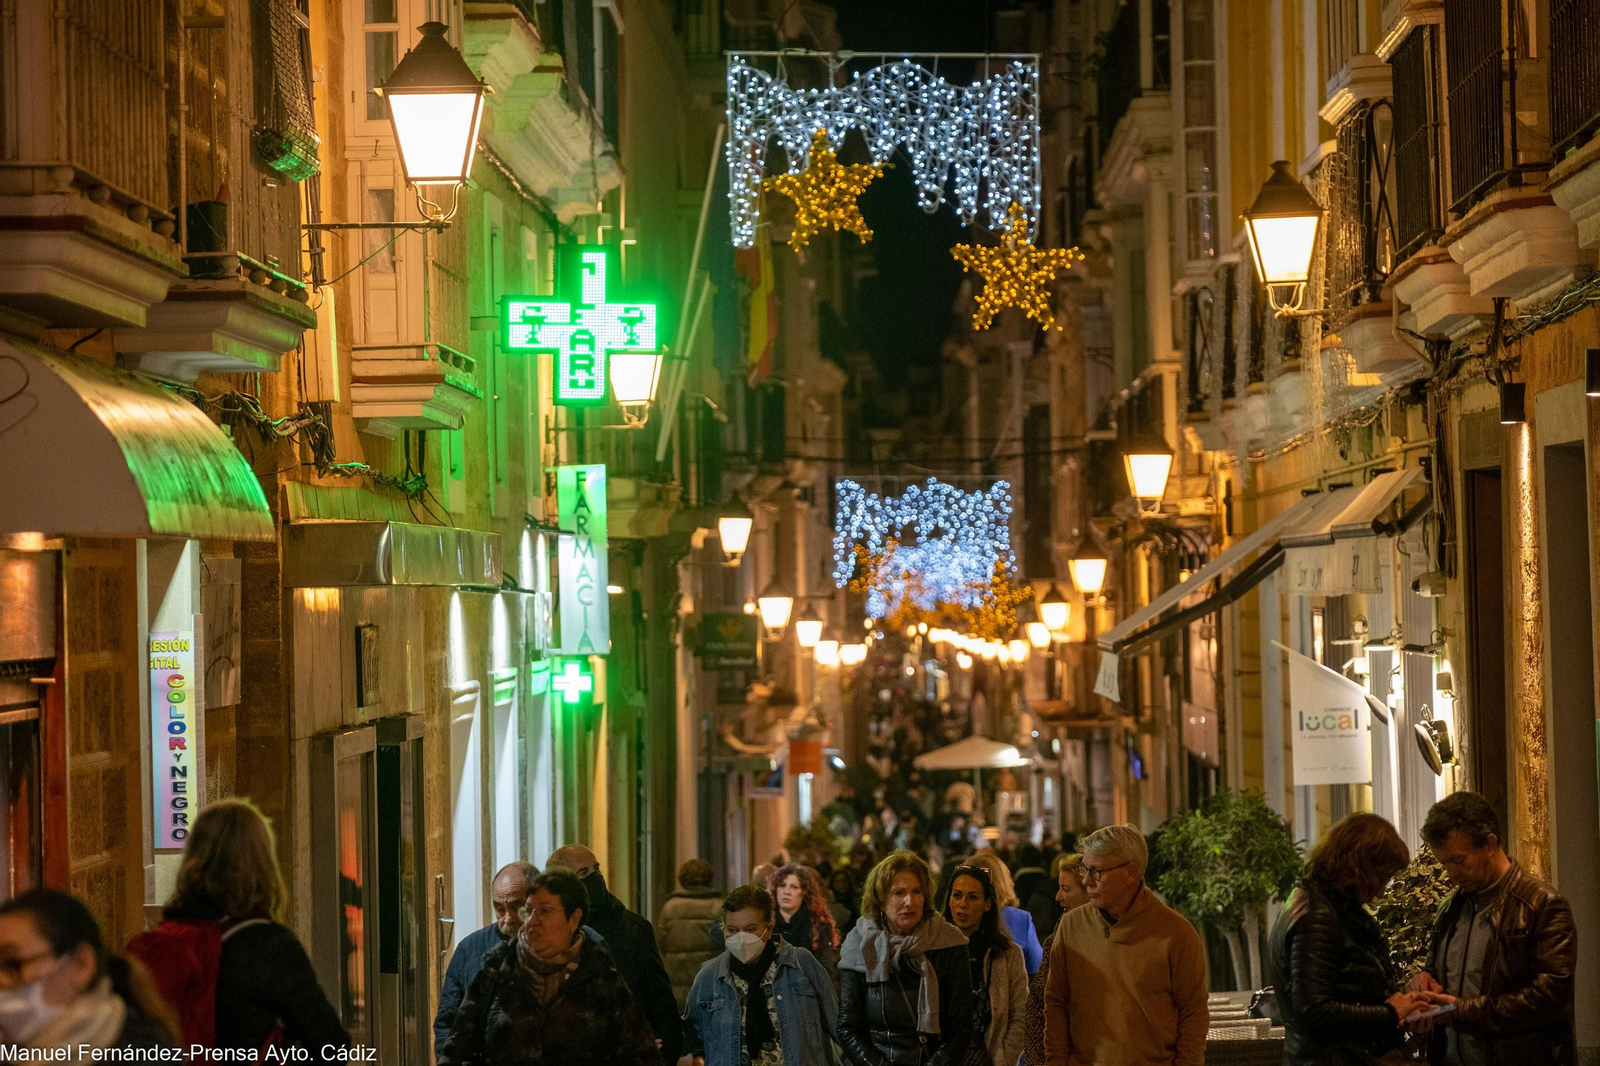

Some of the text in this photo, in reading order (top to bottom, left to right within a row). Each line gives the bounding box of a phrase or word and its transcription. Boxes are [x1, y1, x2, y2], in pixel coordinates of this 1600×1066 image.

[151, 636, 190, 652] ESIÓN
[573, 471, 596, 652] FARMACIA
[167, 674, 189, 842] COLOR Y NEGRO
